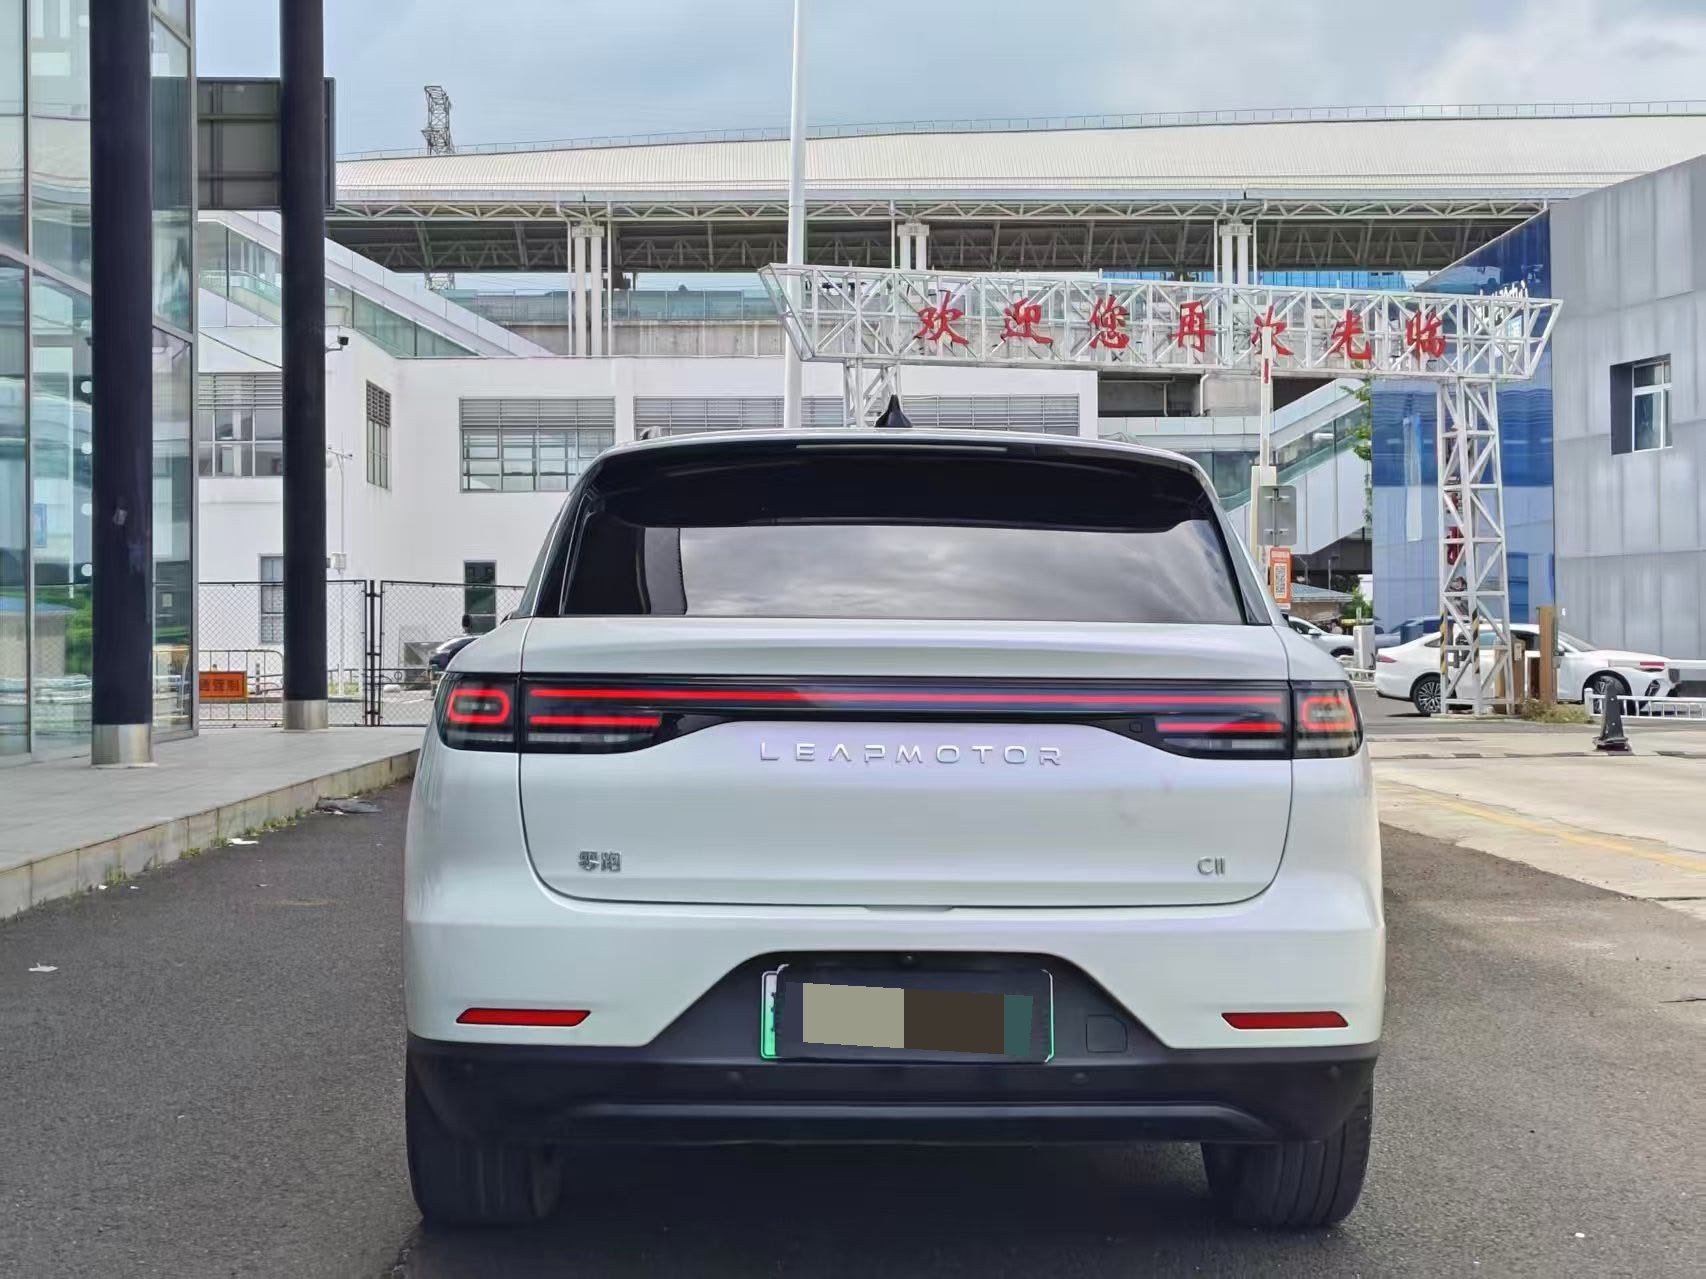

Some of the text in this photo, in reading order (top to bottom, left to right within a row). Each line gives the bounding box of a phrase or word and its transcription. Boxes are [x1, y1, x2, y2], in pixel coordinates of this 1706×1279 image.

[917, 290, 1446, 361] 欢迎您再次光临
[761, 742, 1062, 766] LEAPMOTOR
